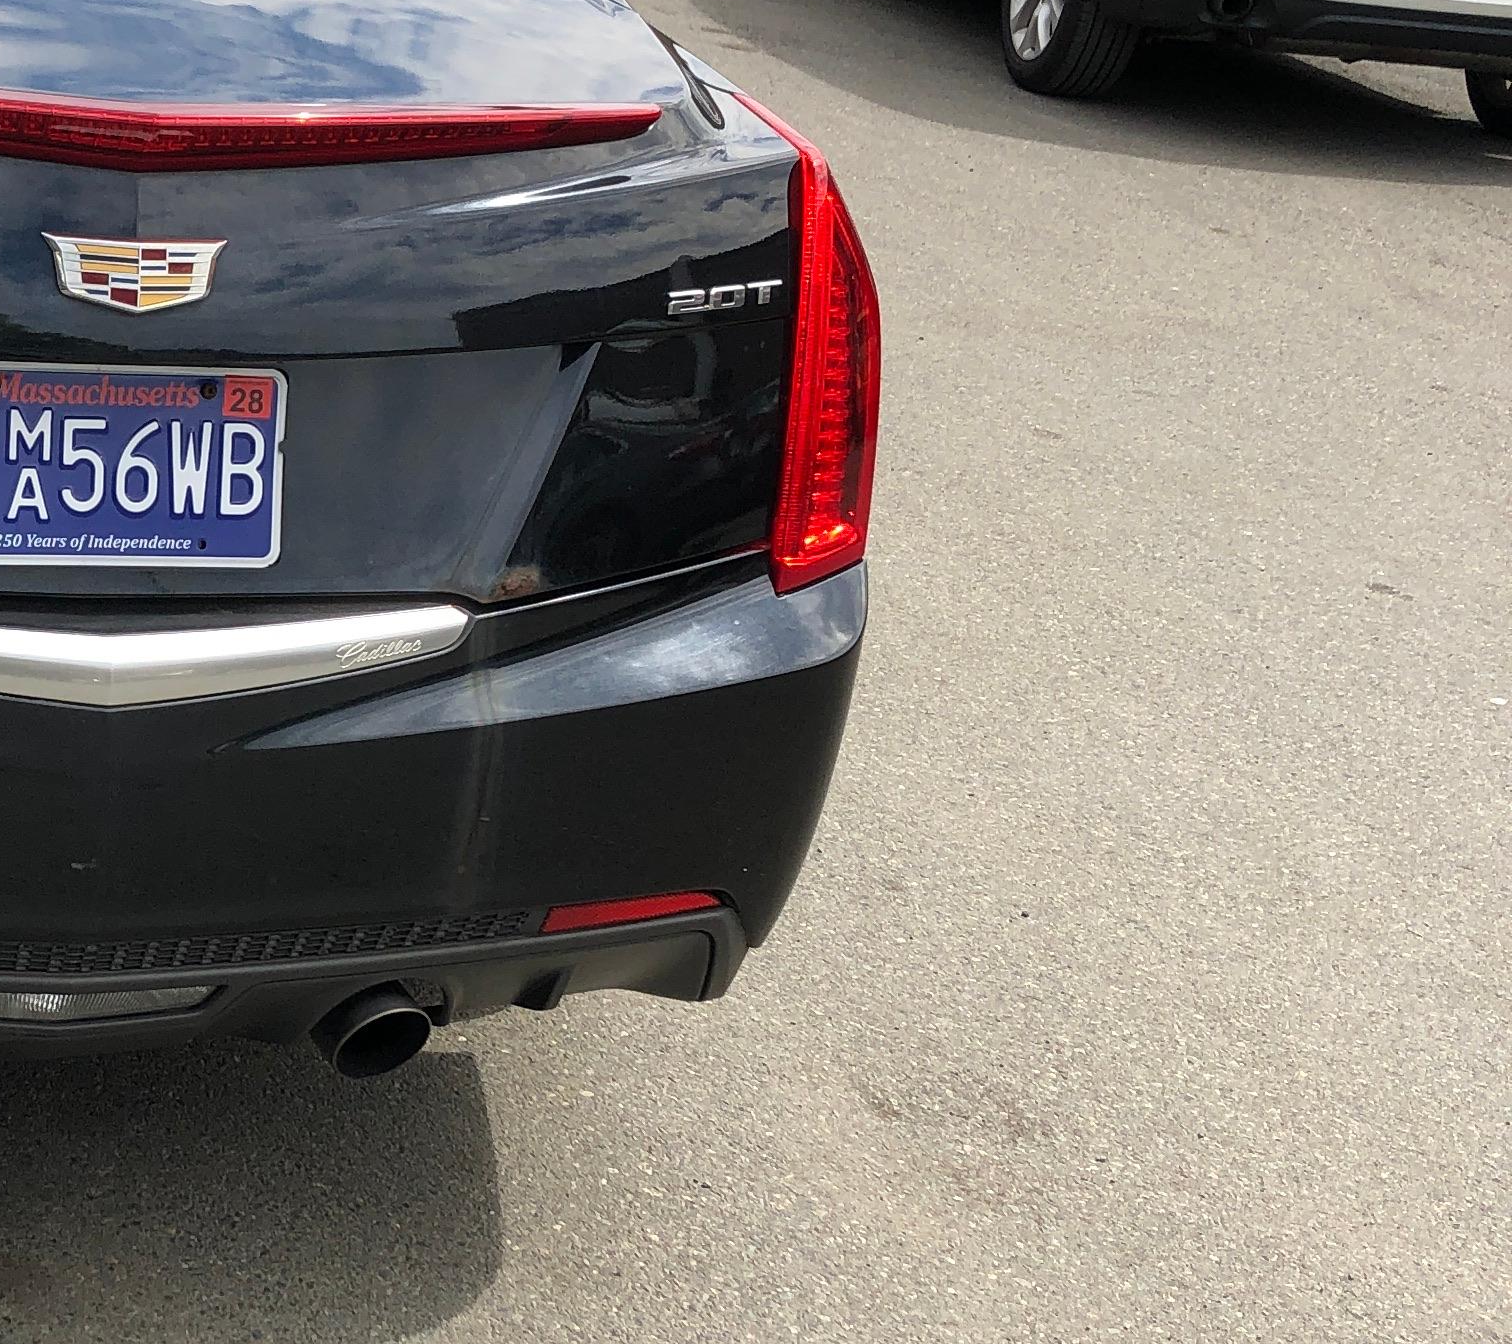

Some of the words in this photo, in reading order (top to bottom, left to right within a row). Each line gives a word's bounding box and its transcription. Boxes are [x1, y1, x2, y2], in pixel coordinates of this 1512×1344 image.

[230, 387, 264, 414] 28
[27, 534, 67, 549] Years
[70, 534, 88, 552] of
[88, 534, 192, 552] Independence
[335, 639, 422, 669] Cadillac
